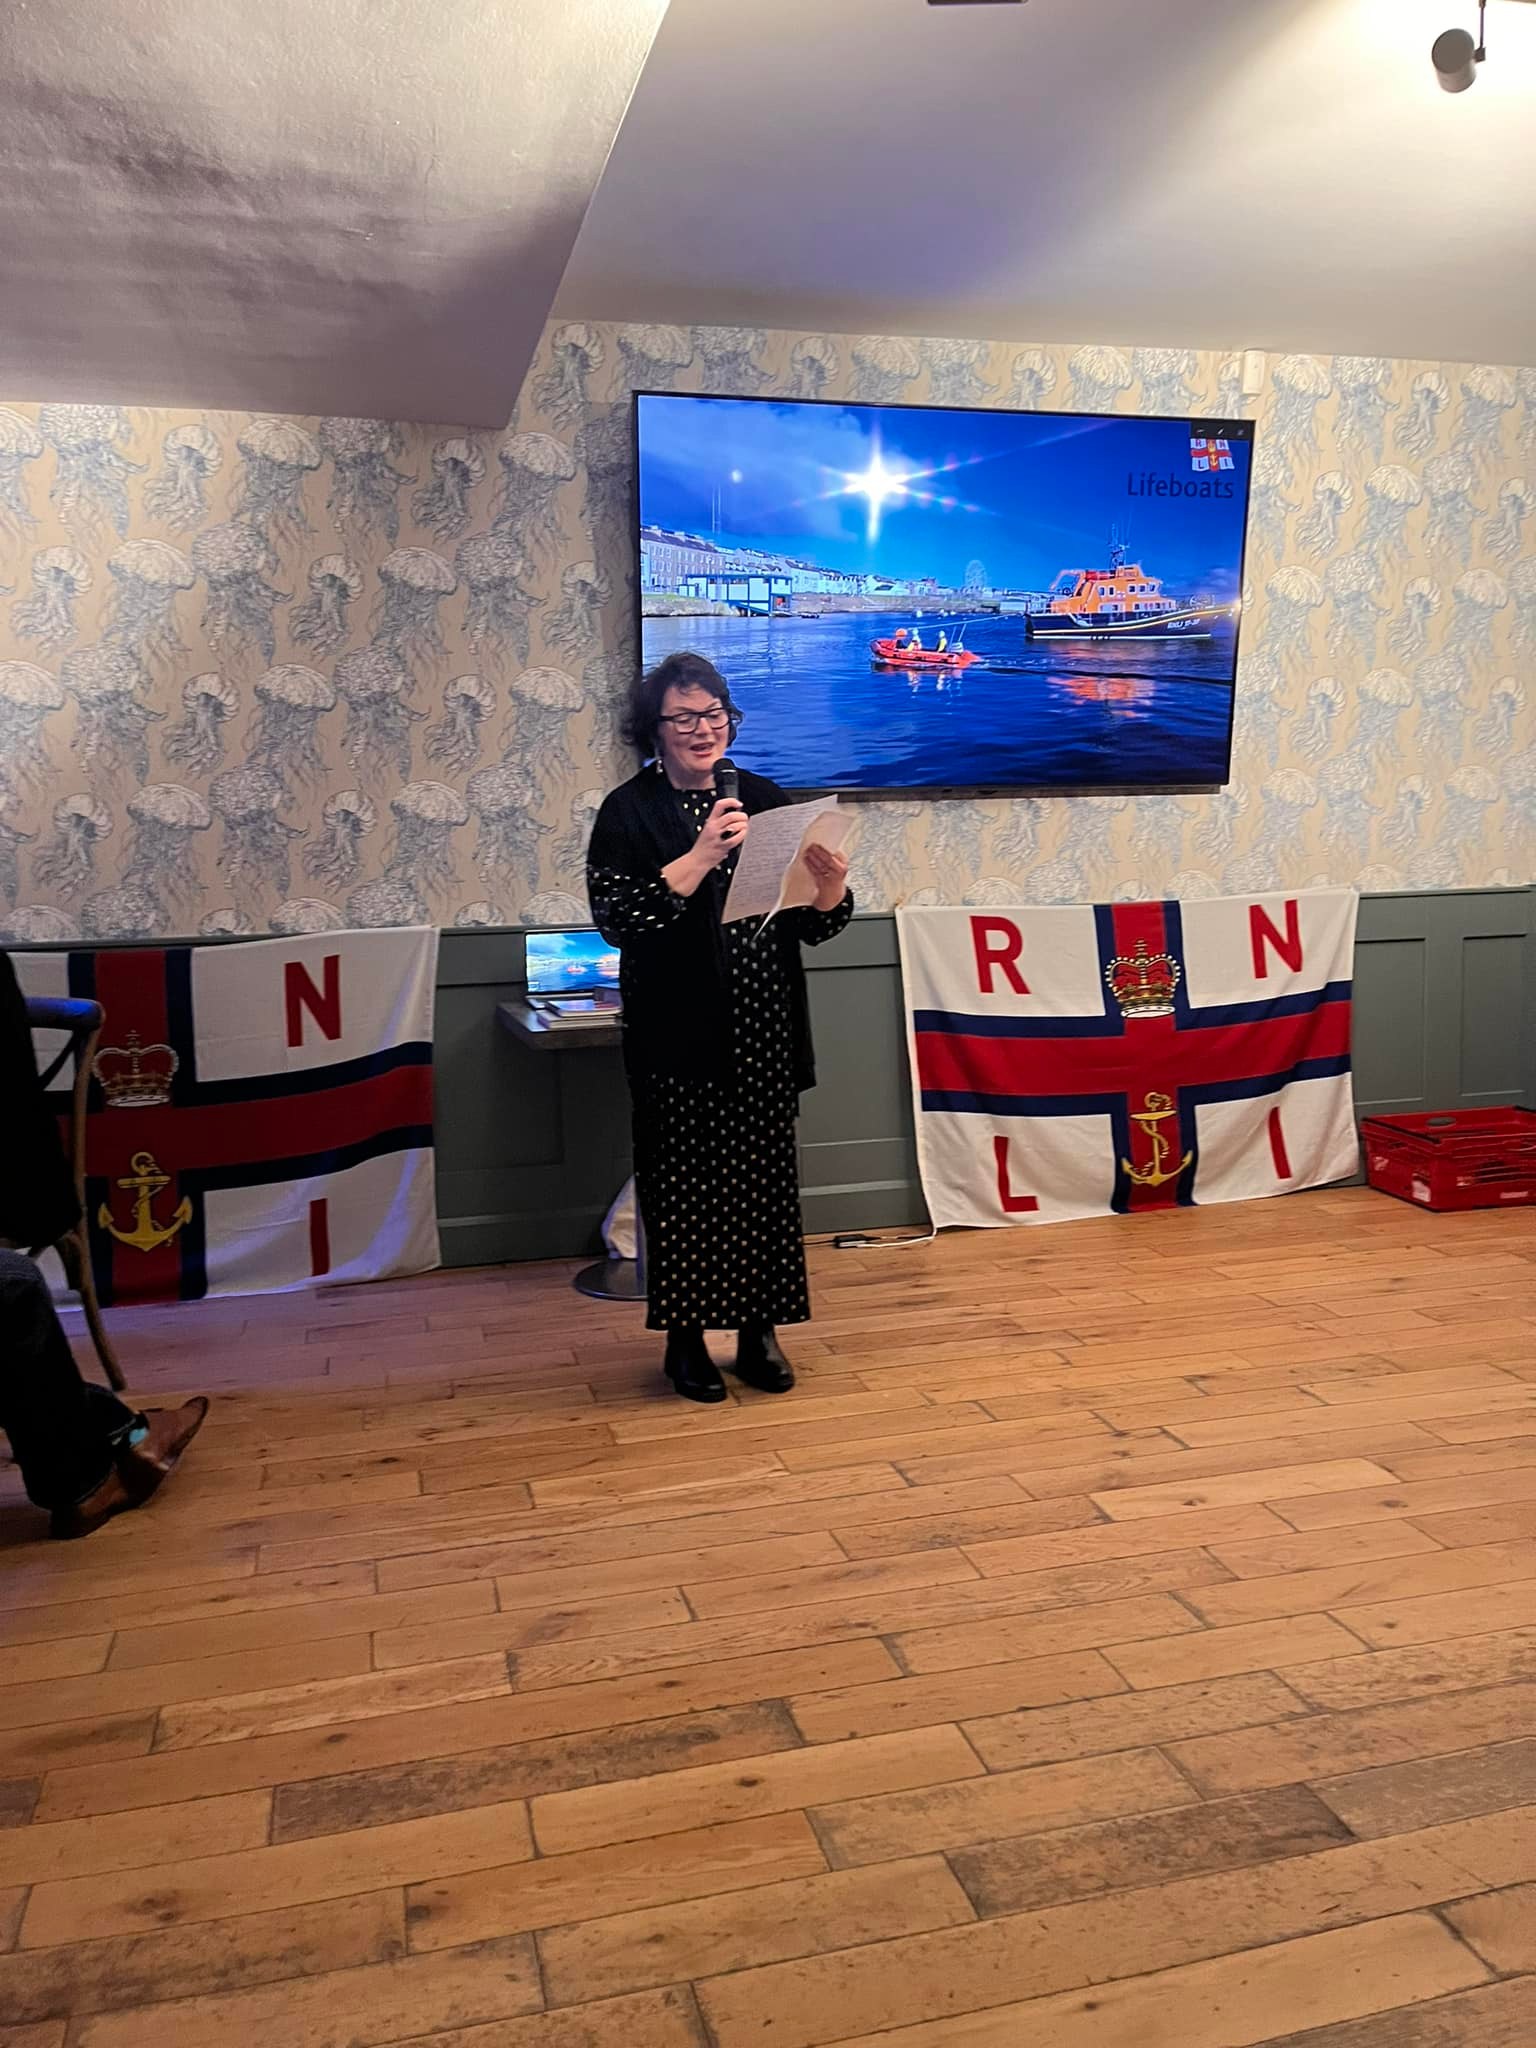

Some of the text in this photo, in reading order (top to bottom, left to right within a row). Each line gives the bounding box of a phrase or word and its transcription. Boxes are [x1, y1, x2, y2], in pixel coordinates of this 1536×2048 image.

[1128, 472, 1233, 499] Lifeboats
[970, 899, 1304, 995] R N
[284, 954, 342, 1048] N
[993, 1106, 1293, 1213] L I
[309, 1198, 330, 1277] I
